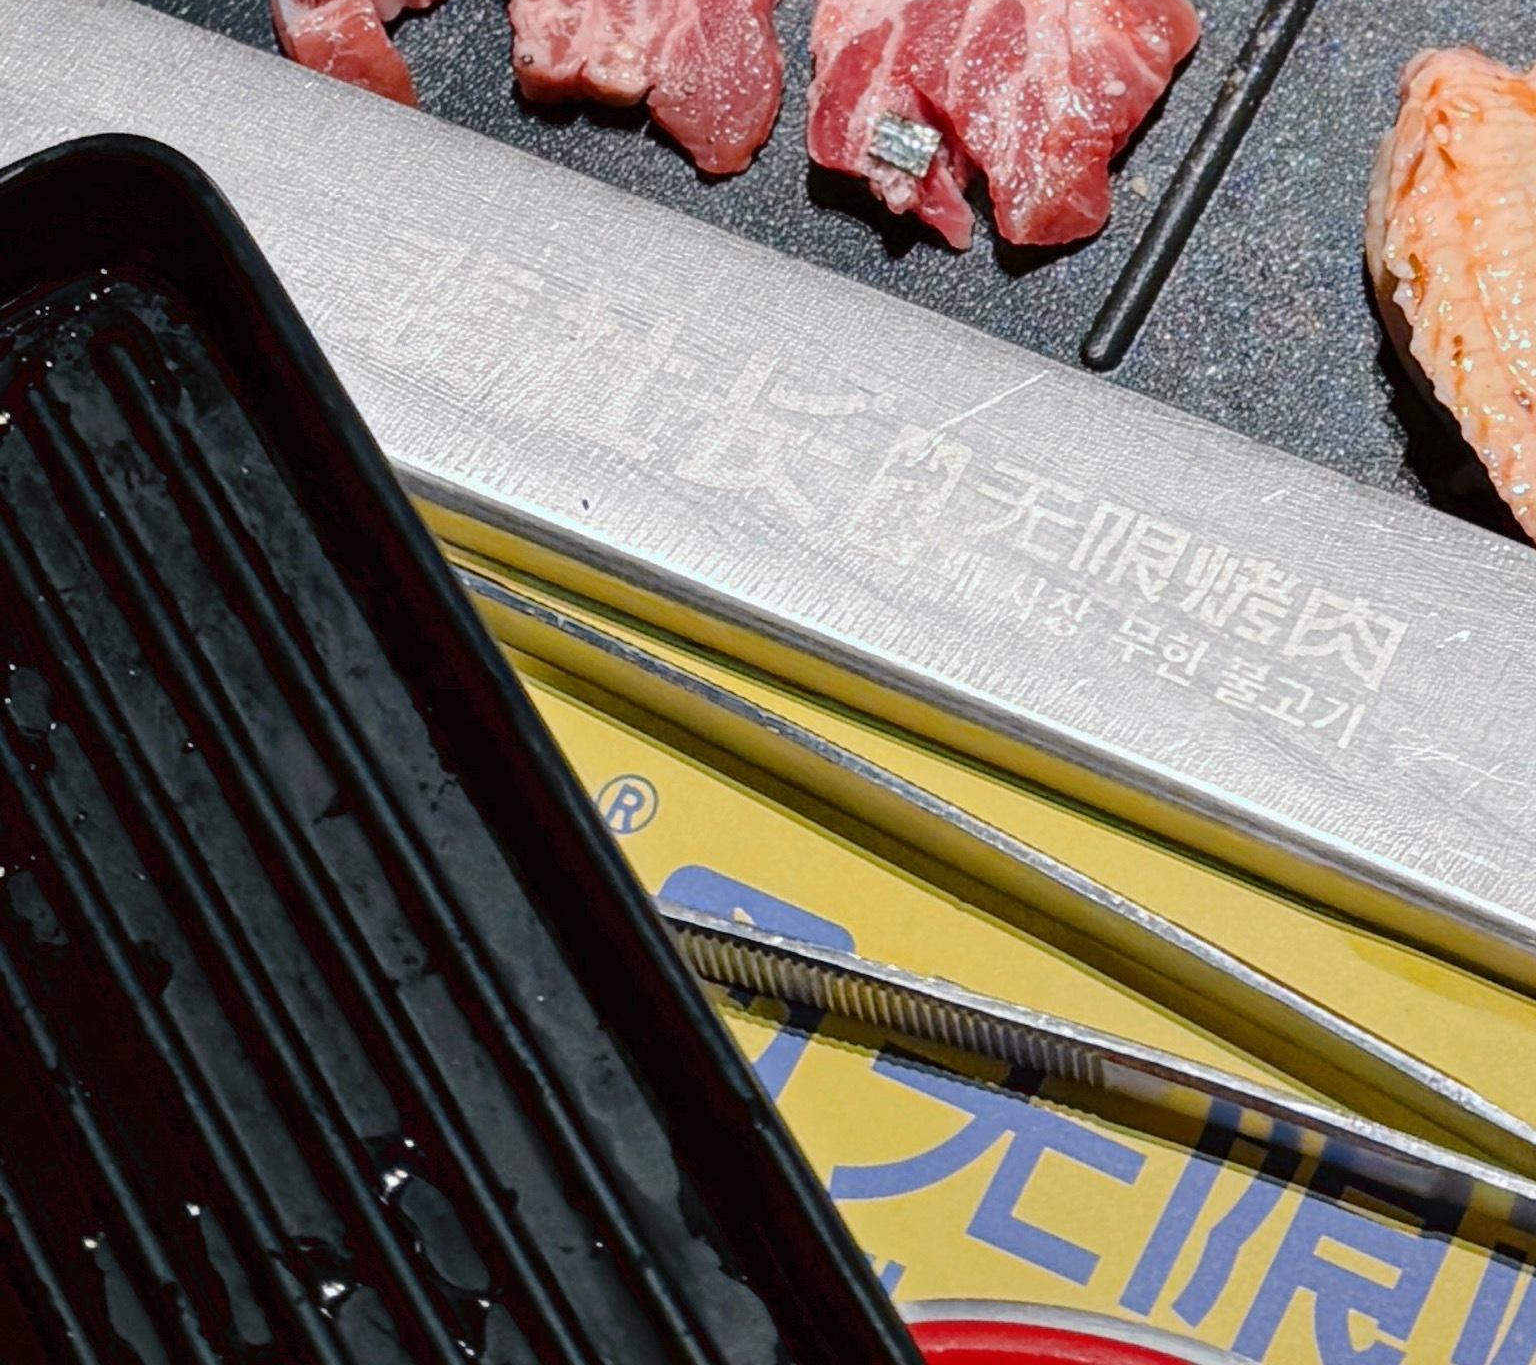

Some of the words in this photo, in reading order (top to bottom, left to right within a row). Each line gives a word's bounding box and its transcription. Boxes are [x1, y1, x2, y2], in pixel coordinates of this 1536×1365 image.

[968, 466, 1410, 693] 无限烤肉
[1213, 659, 1366, 750] 불고기
